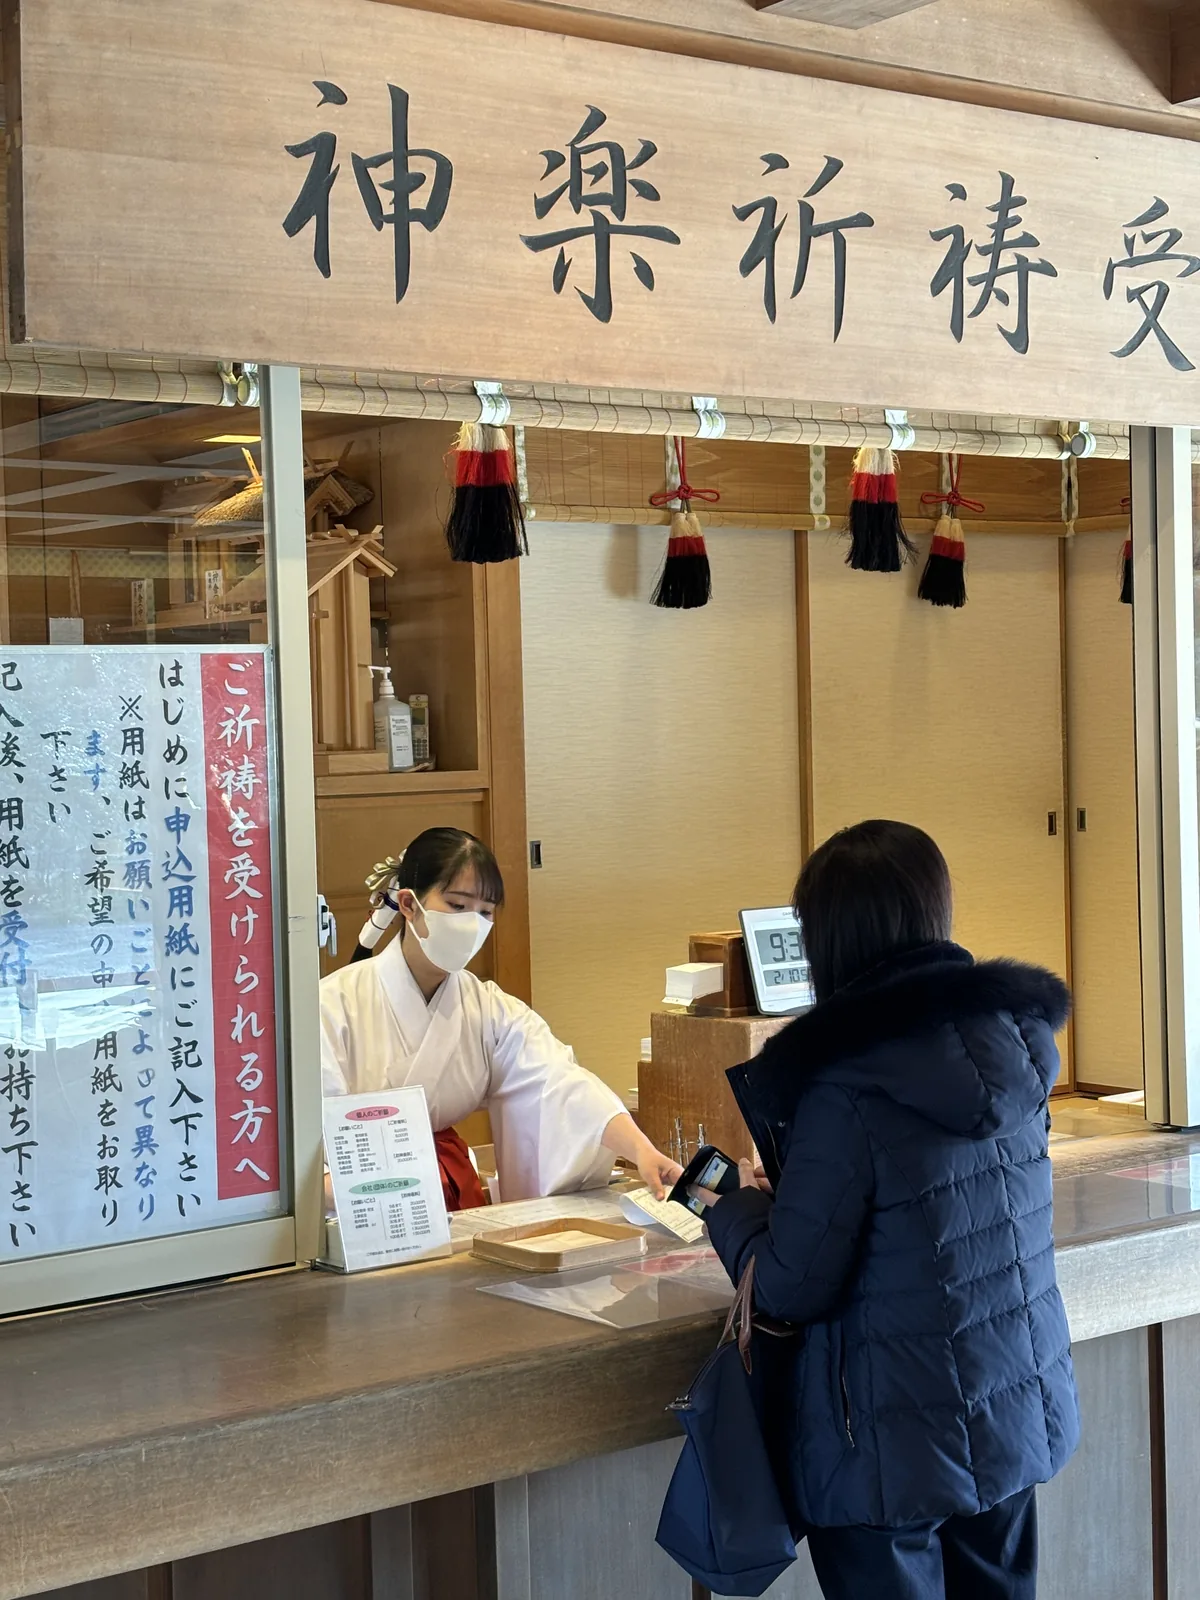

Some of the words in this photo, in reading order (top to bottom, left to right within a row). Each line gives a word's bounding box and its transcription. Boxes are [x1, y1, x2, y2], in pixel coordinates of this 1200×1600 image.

[282, 80, 1200, 372] 神楽祈祷受
[40, 731, 71, 823] 下さい
[84, 730, 123, 1227] ます、ご希望の申用紙をお取り
[159, 658, 204, 1217] はじめに申込用紙にご記入下さい
[217, 659, 272, 1181] ご祈祷を受けられる方へ
